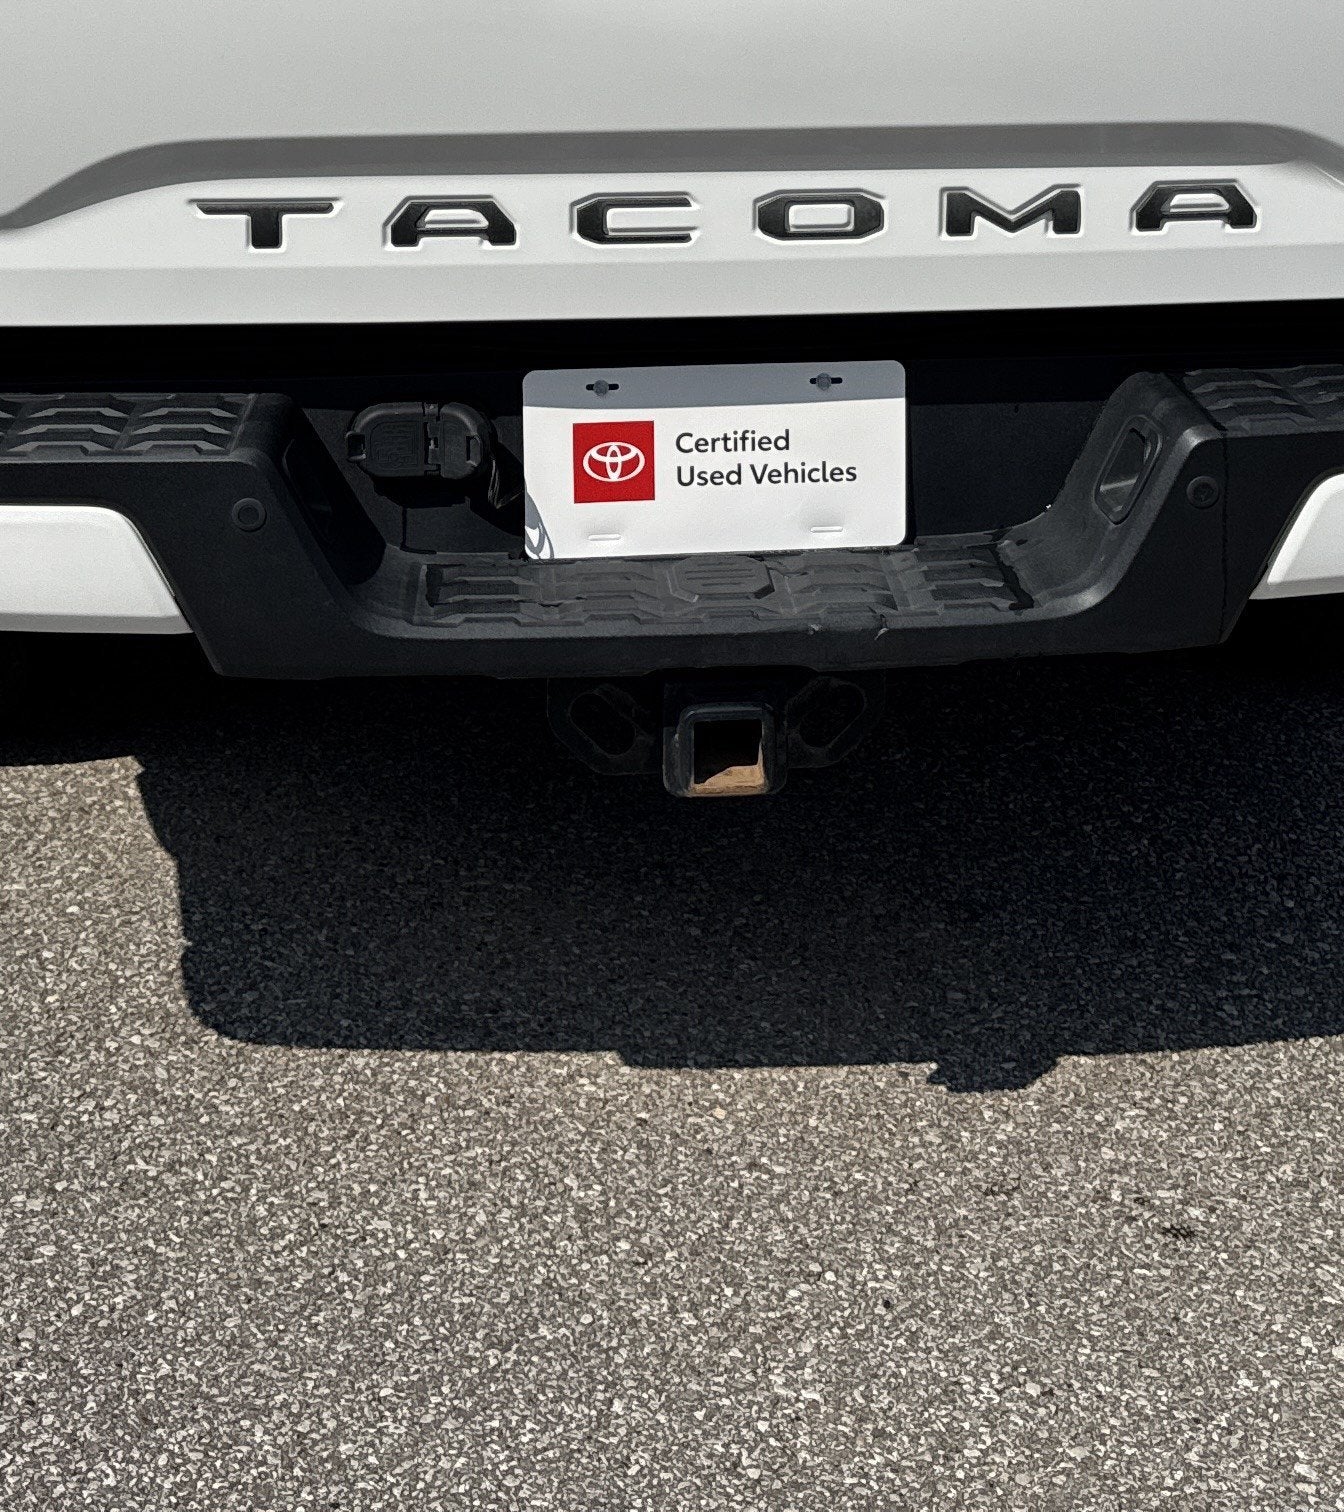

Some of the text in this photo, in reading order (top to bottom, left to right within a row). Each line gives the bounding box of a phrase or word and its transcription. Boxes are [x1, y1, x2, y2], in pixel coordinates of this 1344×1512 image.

[187, 178, 1259, 251] TACOMA
[674, 428, 790, 454] Certified
[675, 460, 858, 487] Used Vehicles
